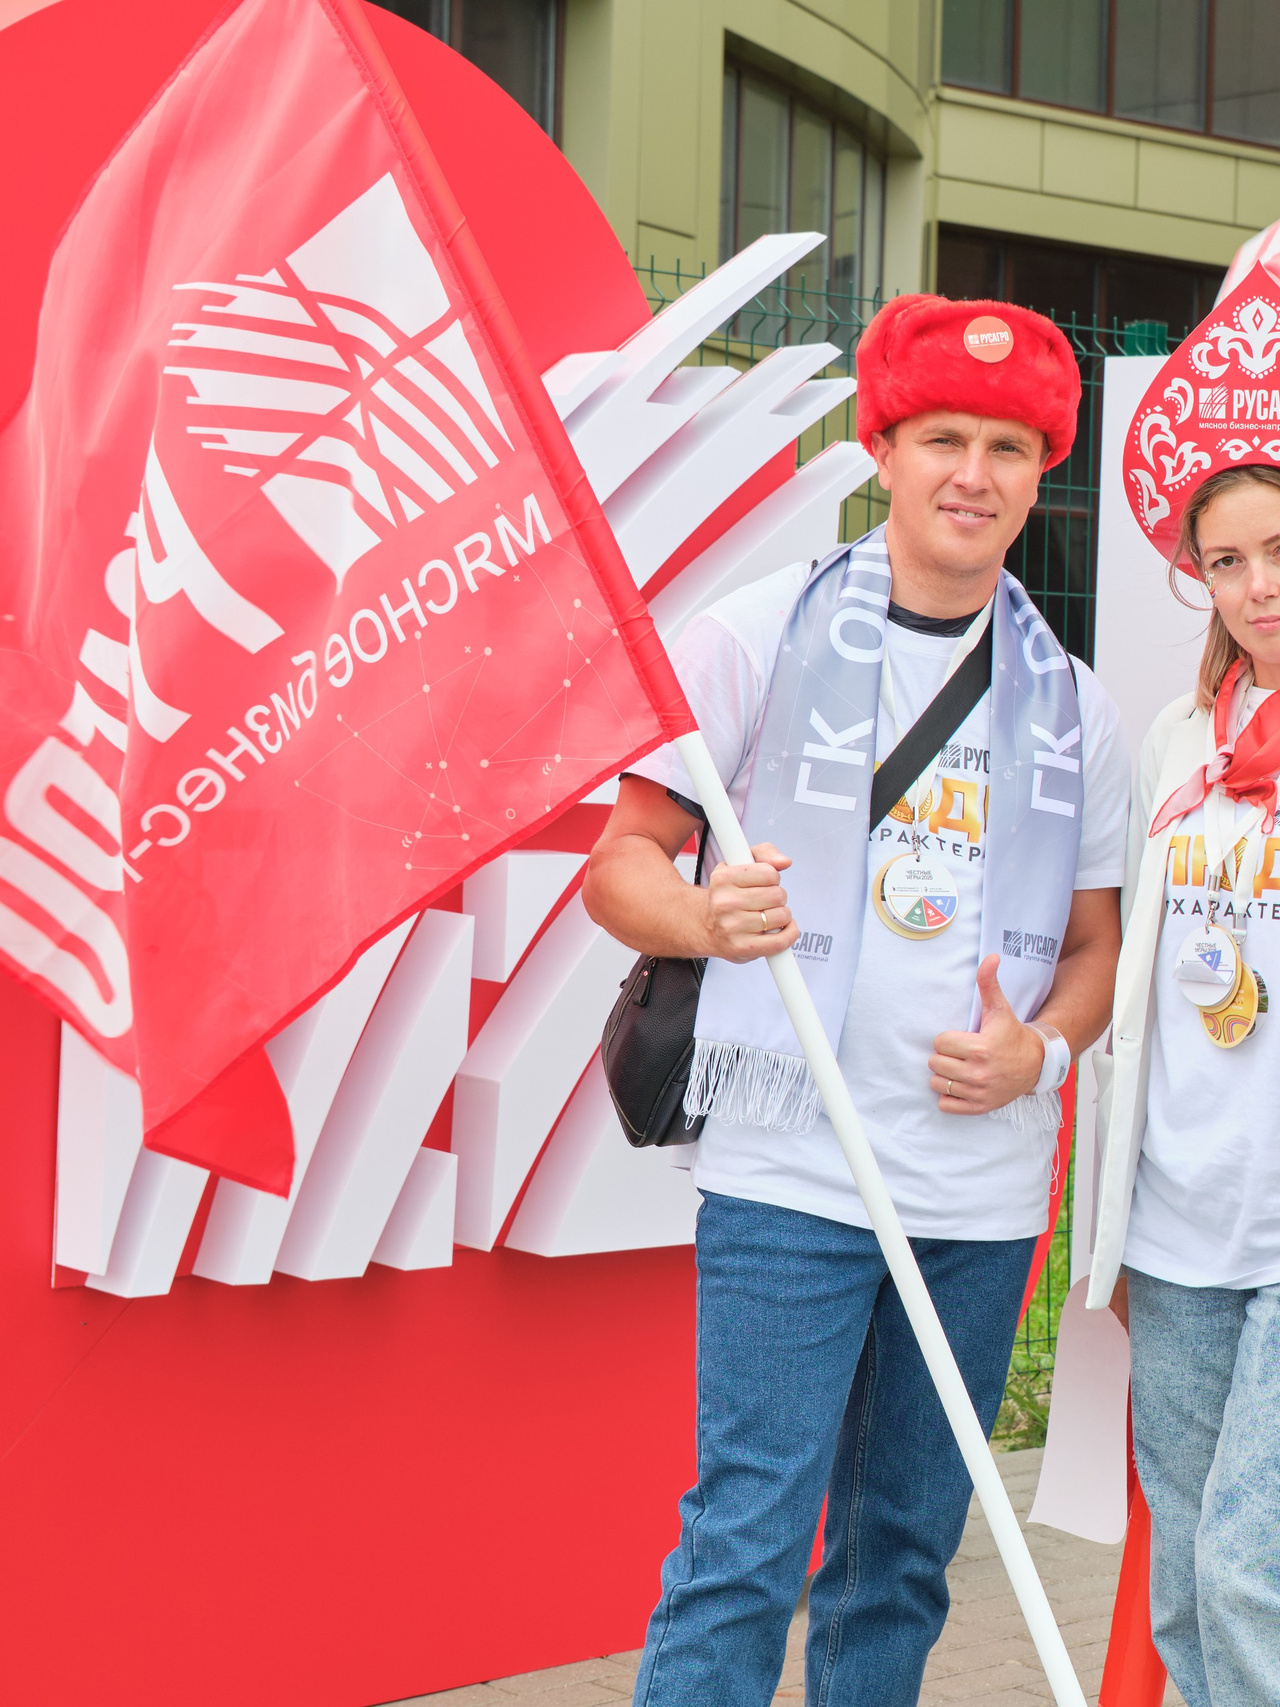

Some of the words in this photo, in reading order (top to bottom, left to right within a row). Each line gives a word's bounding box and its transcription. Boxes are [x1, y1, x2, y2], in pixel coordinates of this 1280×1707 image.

[979, 331, 1010, 345] РУСАГРО
[1199, 422, 1227, 430] мясное
[793, 708, 875, 812] ГК
[1029, 722, 1081, 818] ГК
[1023, 933, 1058, 959] РУСАГРО
